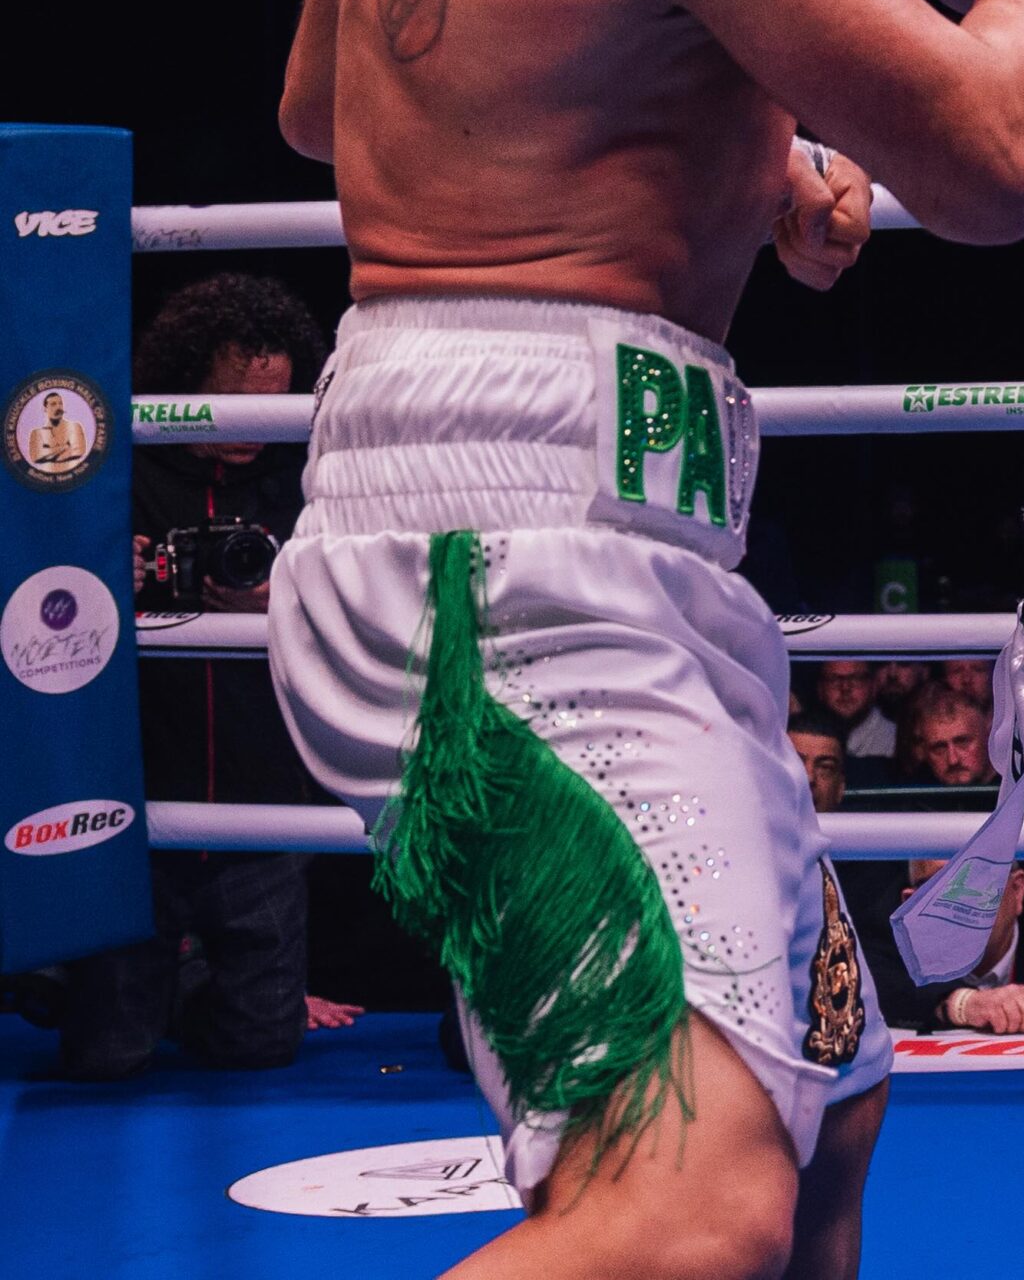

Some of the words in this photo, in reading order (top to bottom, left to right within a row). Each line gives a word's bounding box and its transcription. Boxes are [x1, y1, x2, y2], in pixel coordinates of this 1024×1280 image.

[14, 209, 99, 237] VICE
[160, 424, 216, 433] INSURANCE
[18, 656, 102, 679] COMPETITIONS
